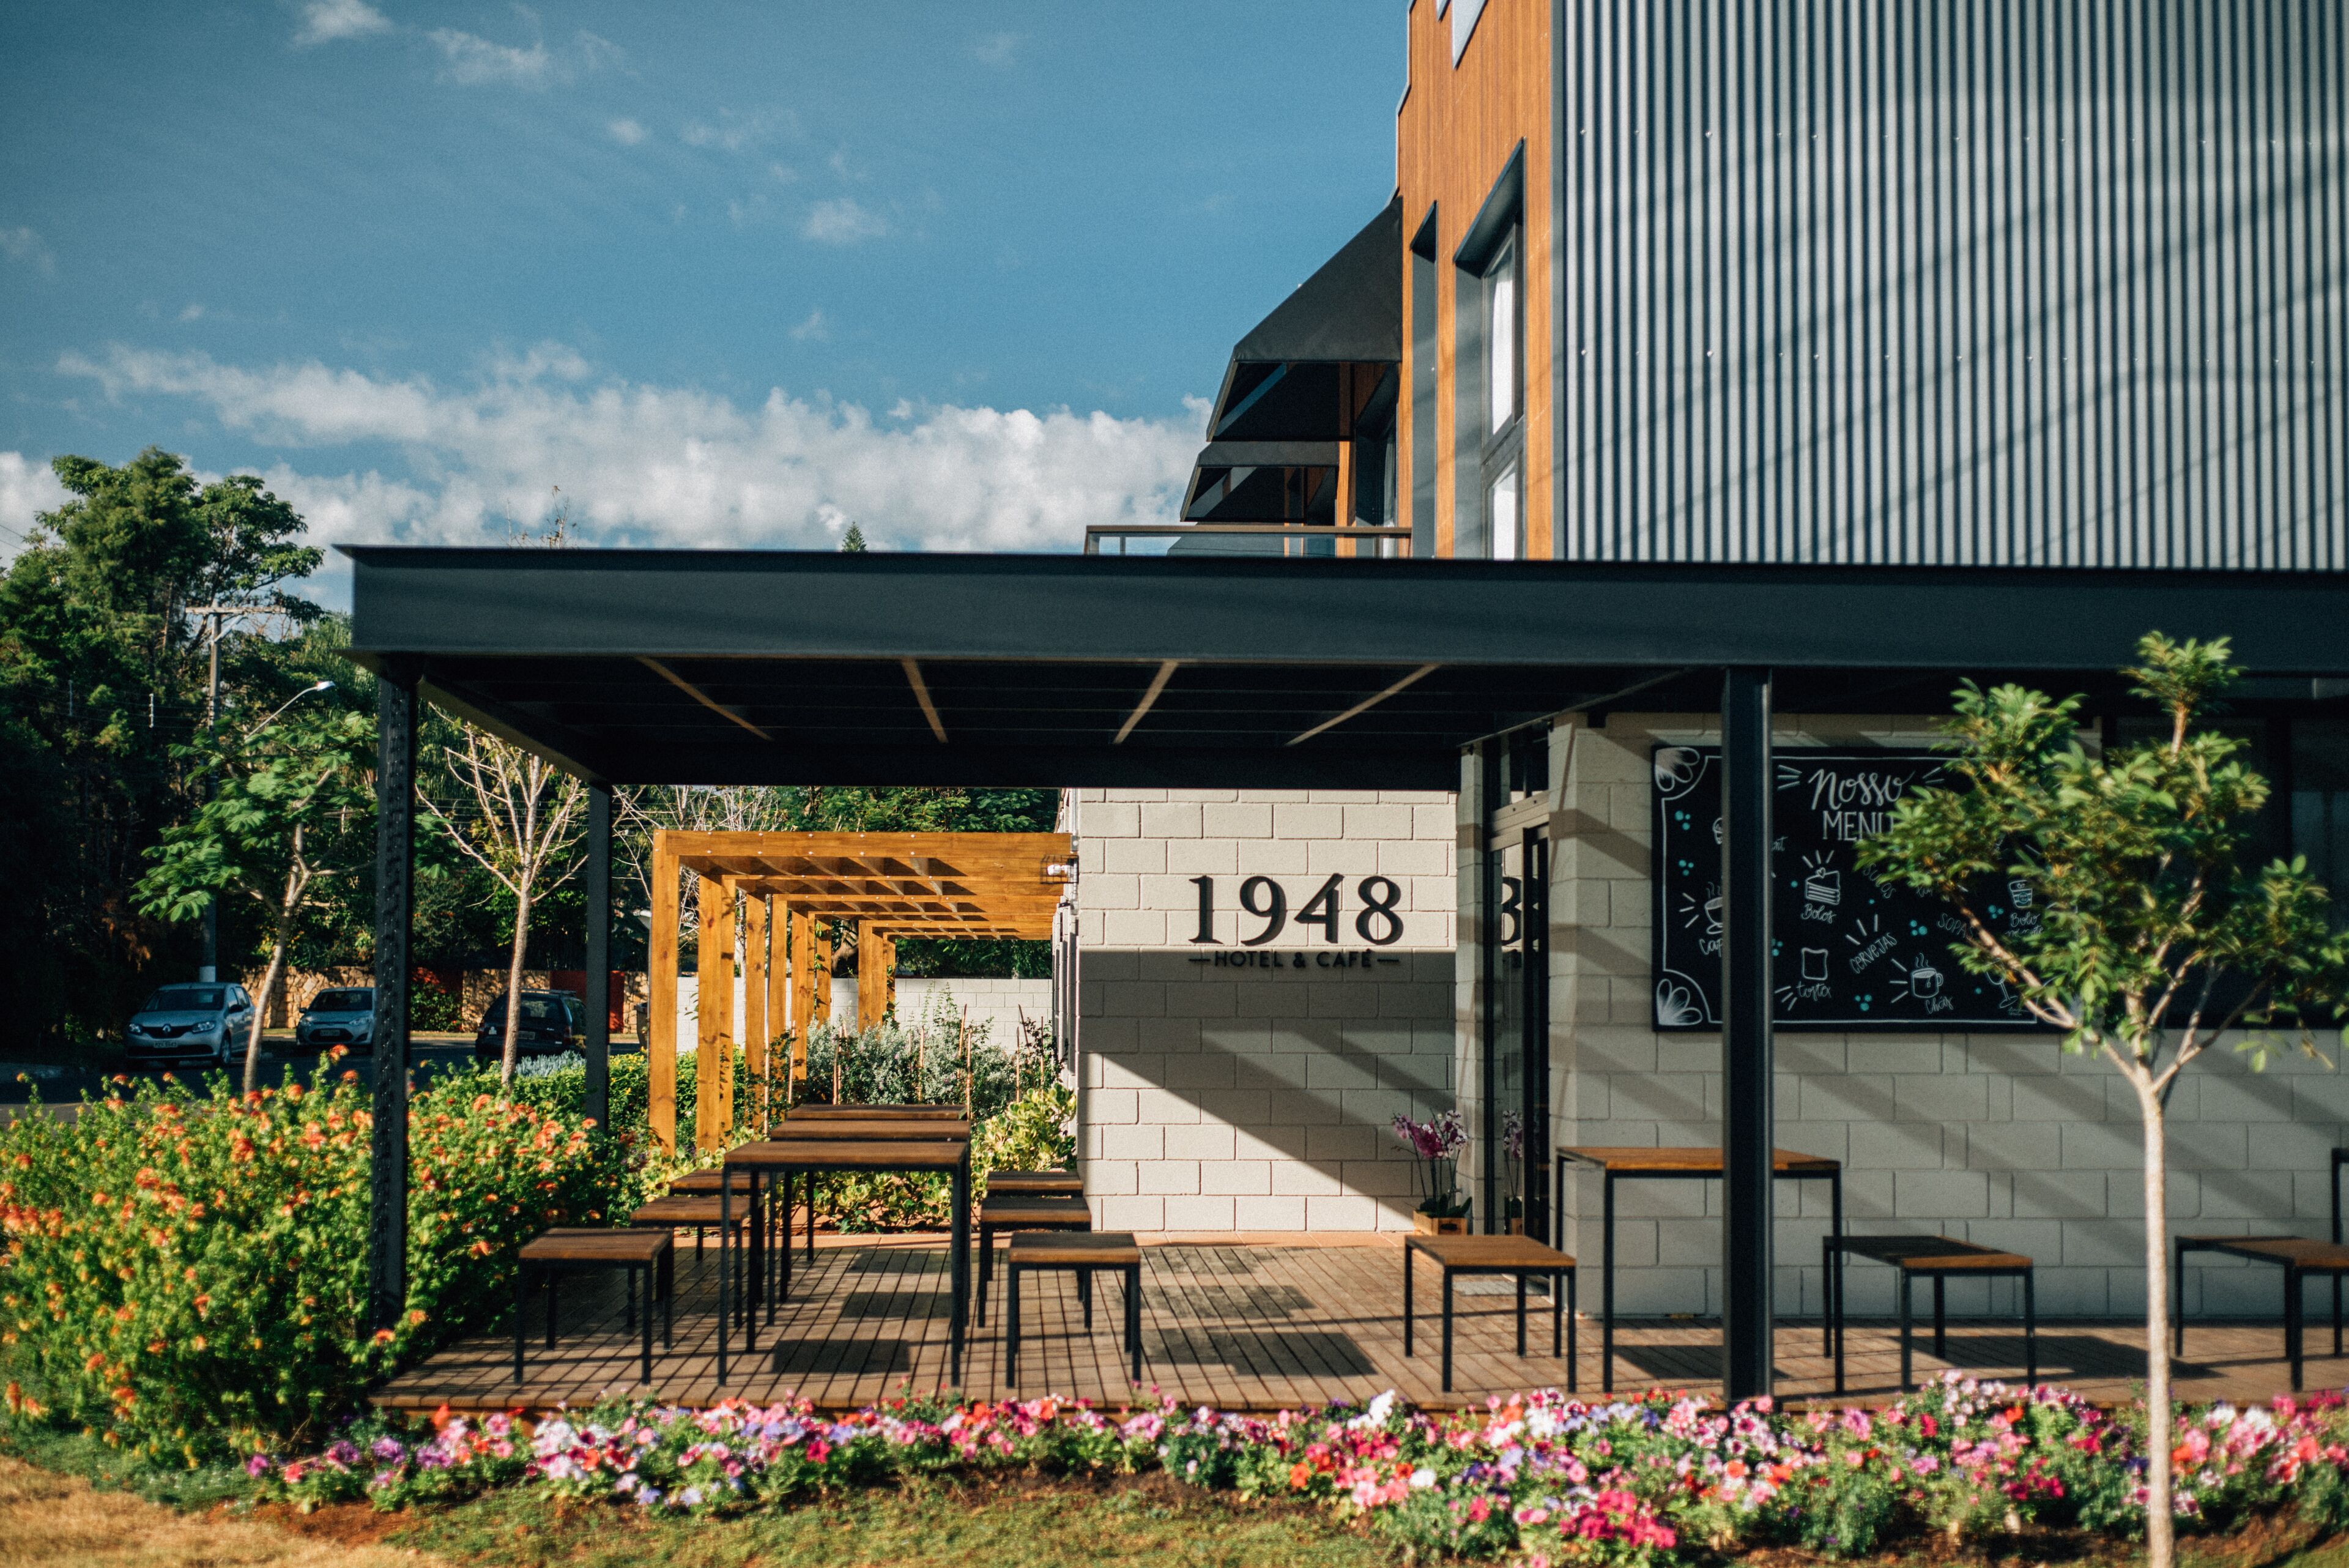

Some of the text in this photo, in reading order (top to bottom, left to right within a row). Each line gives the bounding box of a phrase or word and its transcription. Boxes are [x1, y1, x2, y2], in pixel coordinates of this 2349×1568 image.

[1807, 768, 1915, 811] Nosso
[1822, 811, 1894, 841] MENU
[1862, 863, 1897, 899] SUOS
[1188, 873, 1405, 946] 1948
[1800, 903, 1837, 924] Bolos
[2010, 911, 2041, 927] Bolo
[1214, 951, 1283, 968] HOTEL
[1293, 951, 1307, 968] &
